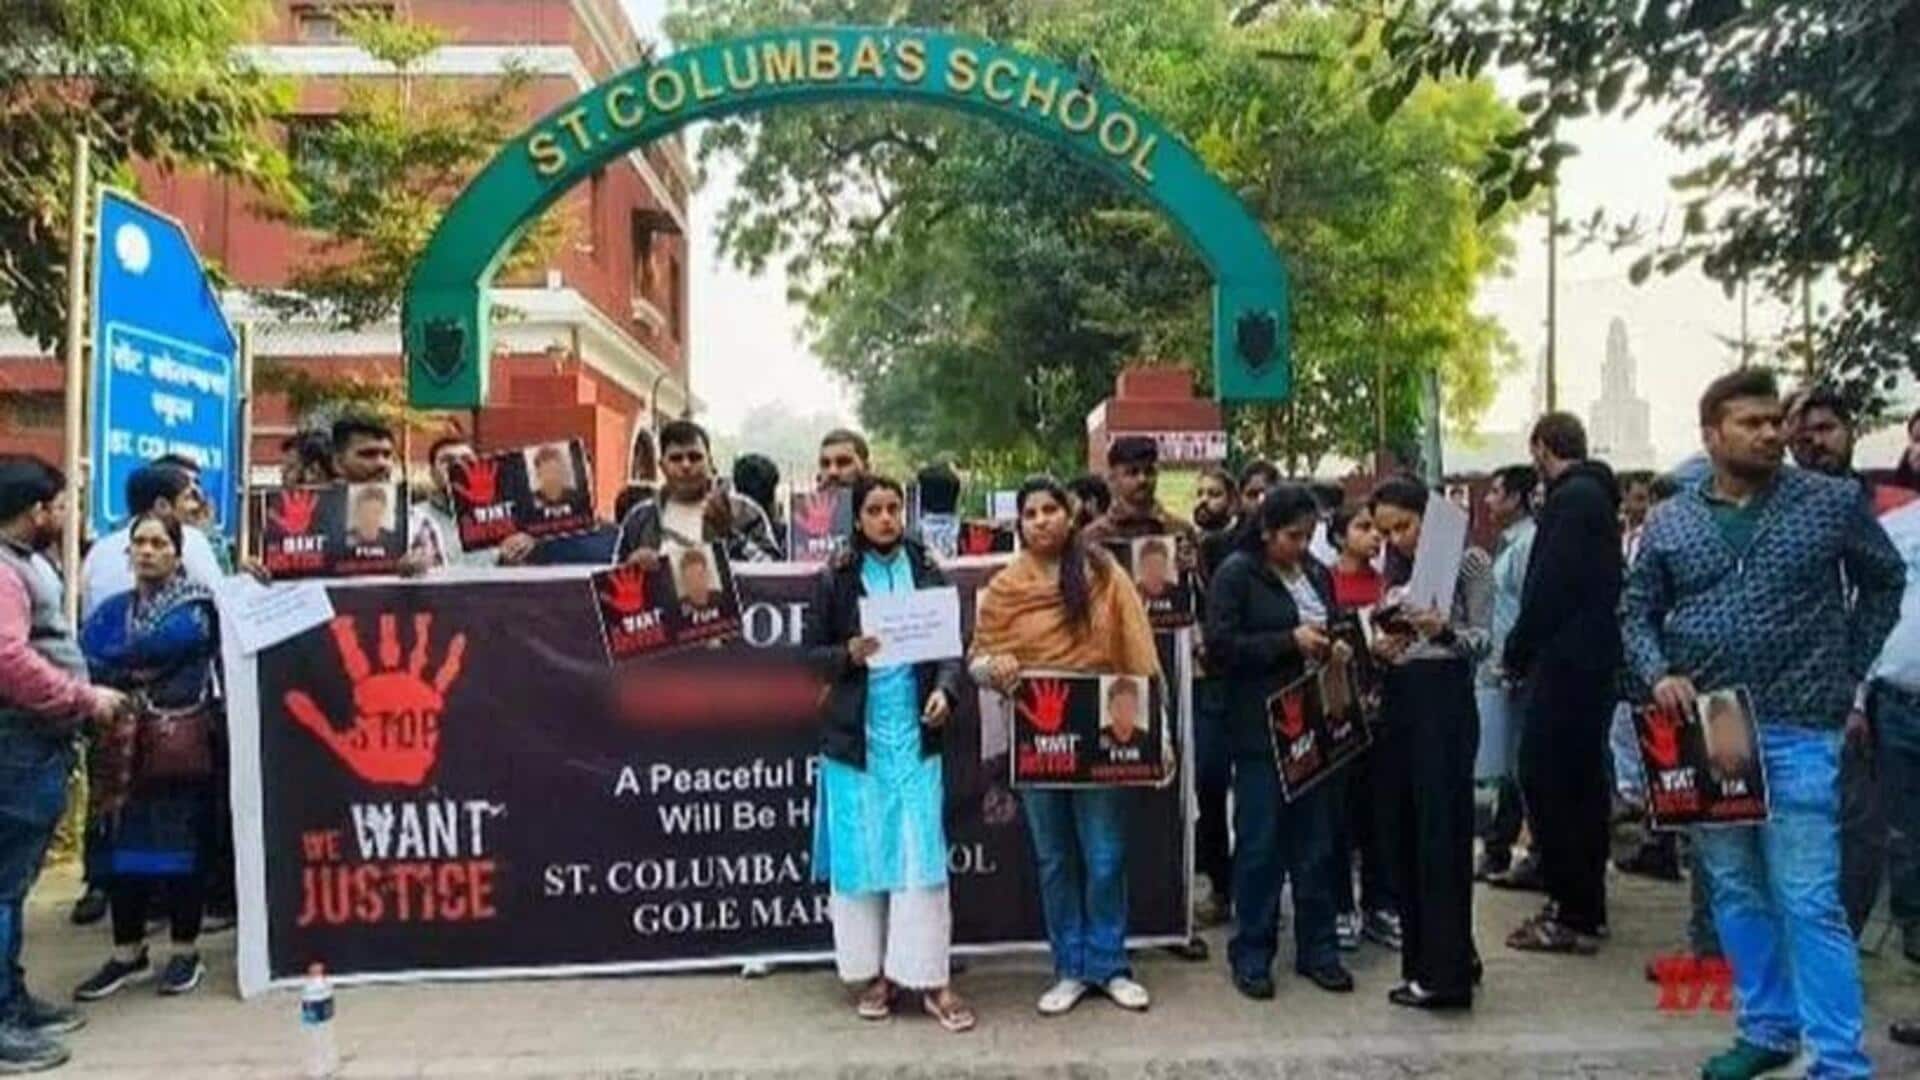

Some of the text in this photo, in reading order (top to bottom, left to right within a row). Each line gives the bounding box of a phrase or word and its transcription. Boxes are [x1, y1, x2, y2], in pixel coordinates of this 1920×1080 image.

[945, 47, 1163, 181] SCHOOL
[614, 765, 641, 796] A
[651, 757, 794, 793] Peaceful
[302, 799, 505, 861] WE WANT
[658, 802, 722, 834] Will
[732, 800, 776, 830] Be
[297, 861, 497, 928] JUSTICE
[543, 850, 811, 896] ST. COLUMBA'
[633, 898, 742, 935] GOLE
